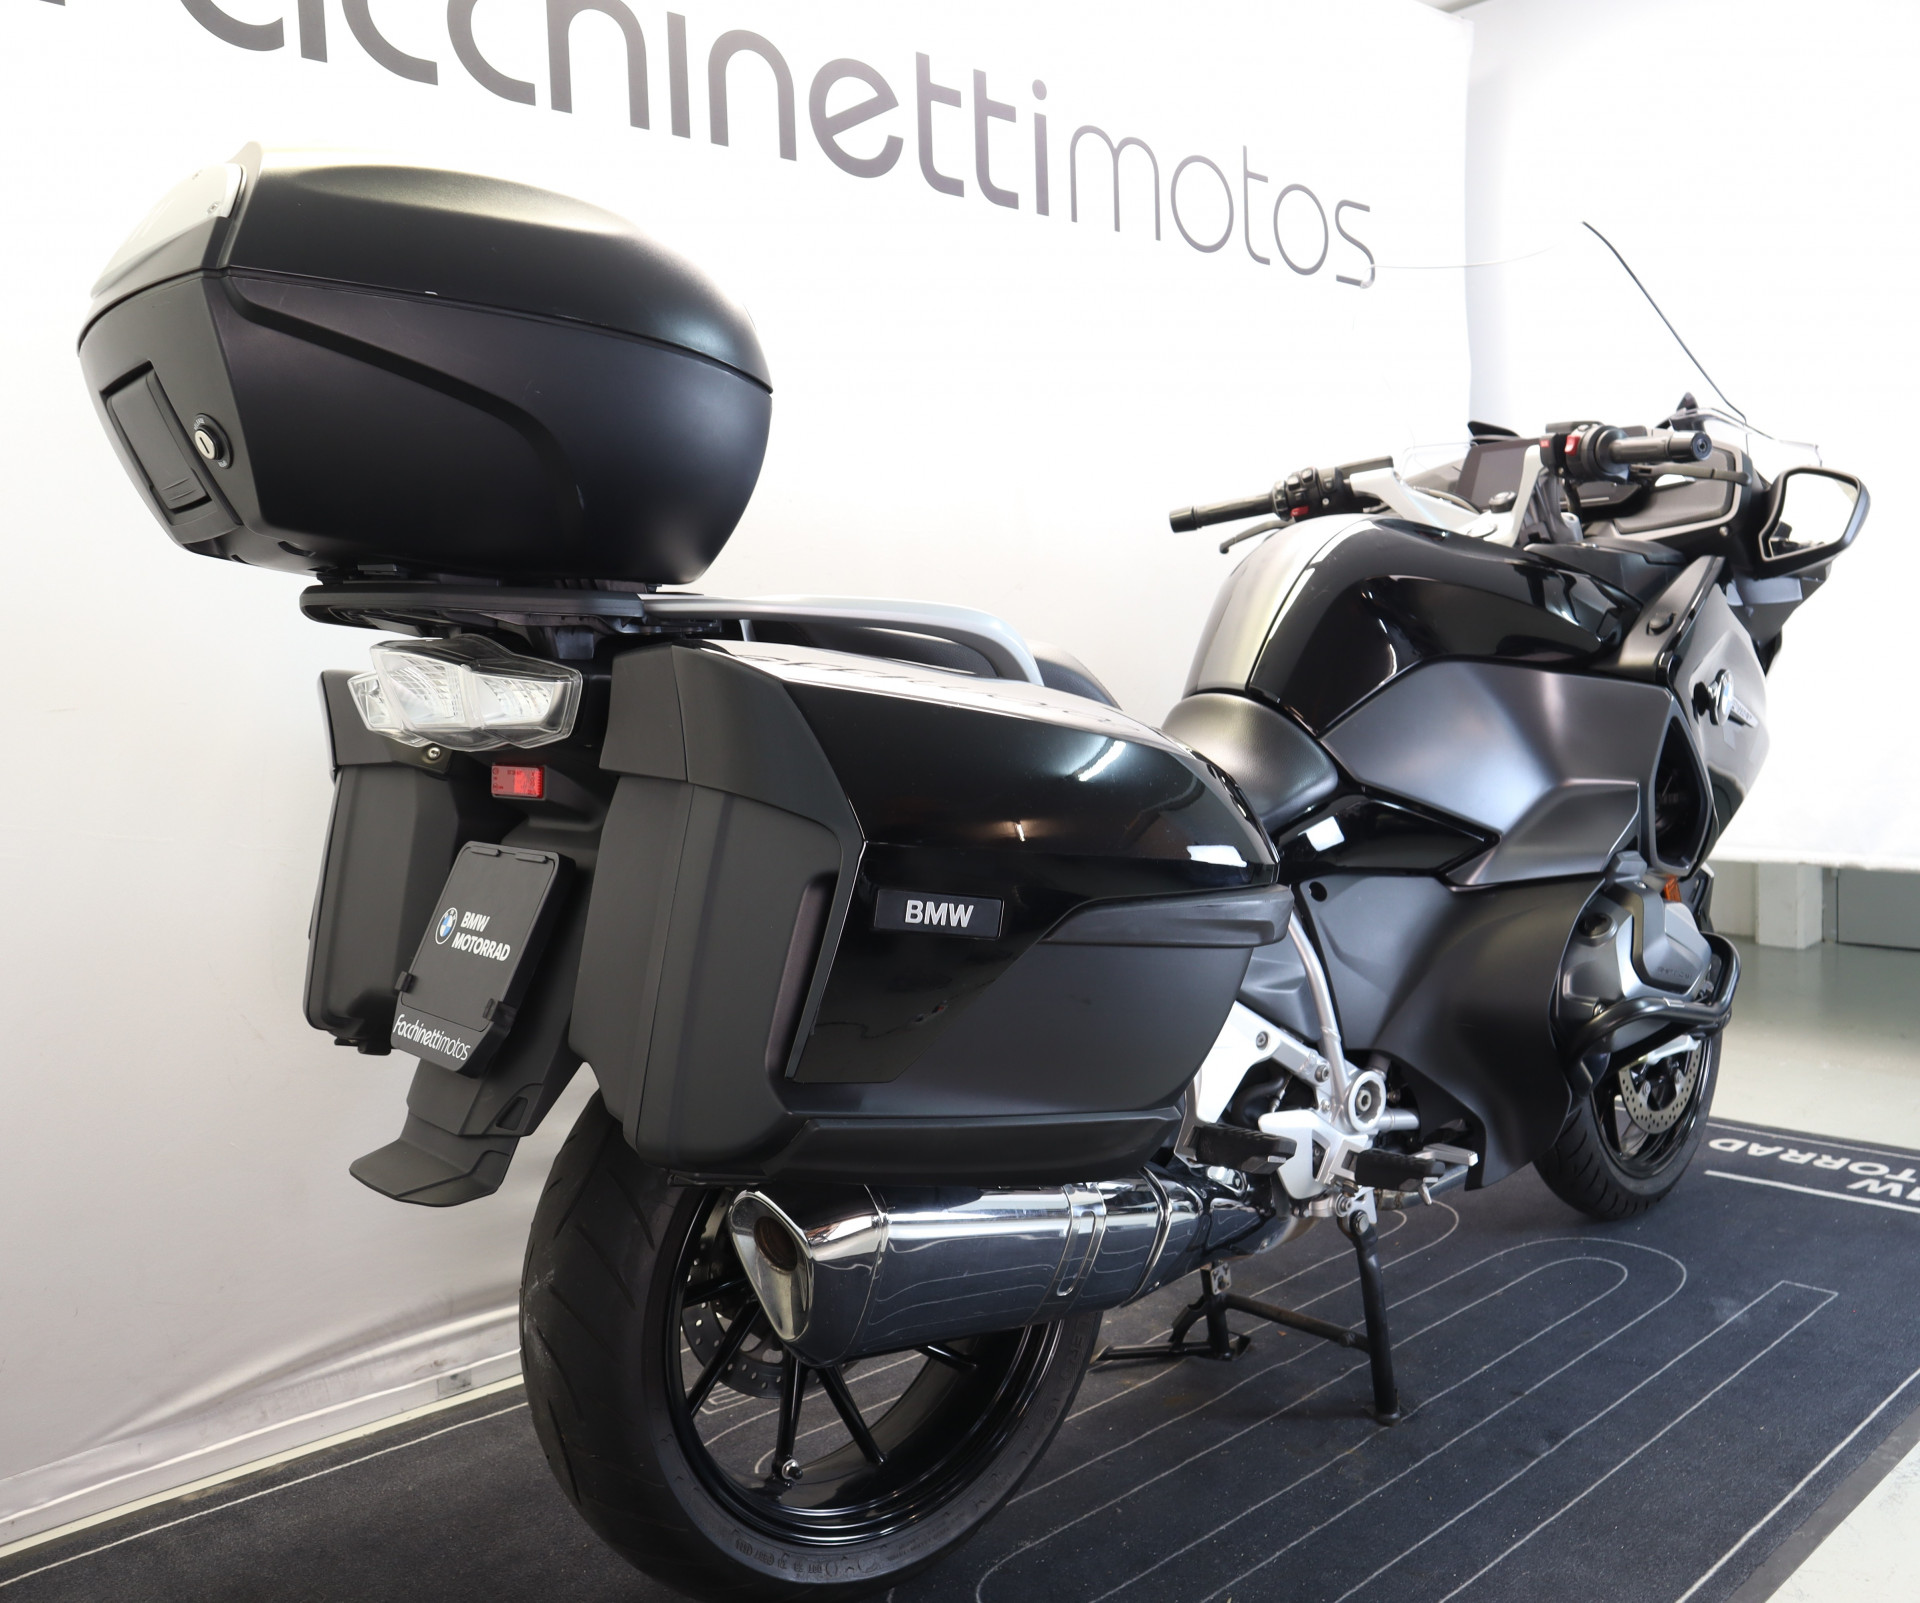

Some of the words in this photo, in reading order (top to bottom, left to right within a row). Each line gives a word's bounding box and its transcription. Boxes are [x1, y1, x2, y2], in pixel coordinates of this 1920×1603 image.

[460, 911, 490, 932] BMW
[904, 899, 974, 928] BMW
[451, 932, 511, 961] MOTORRAD
